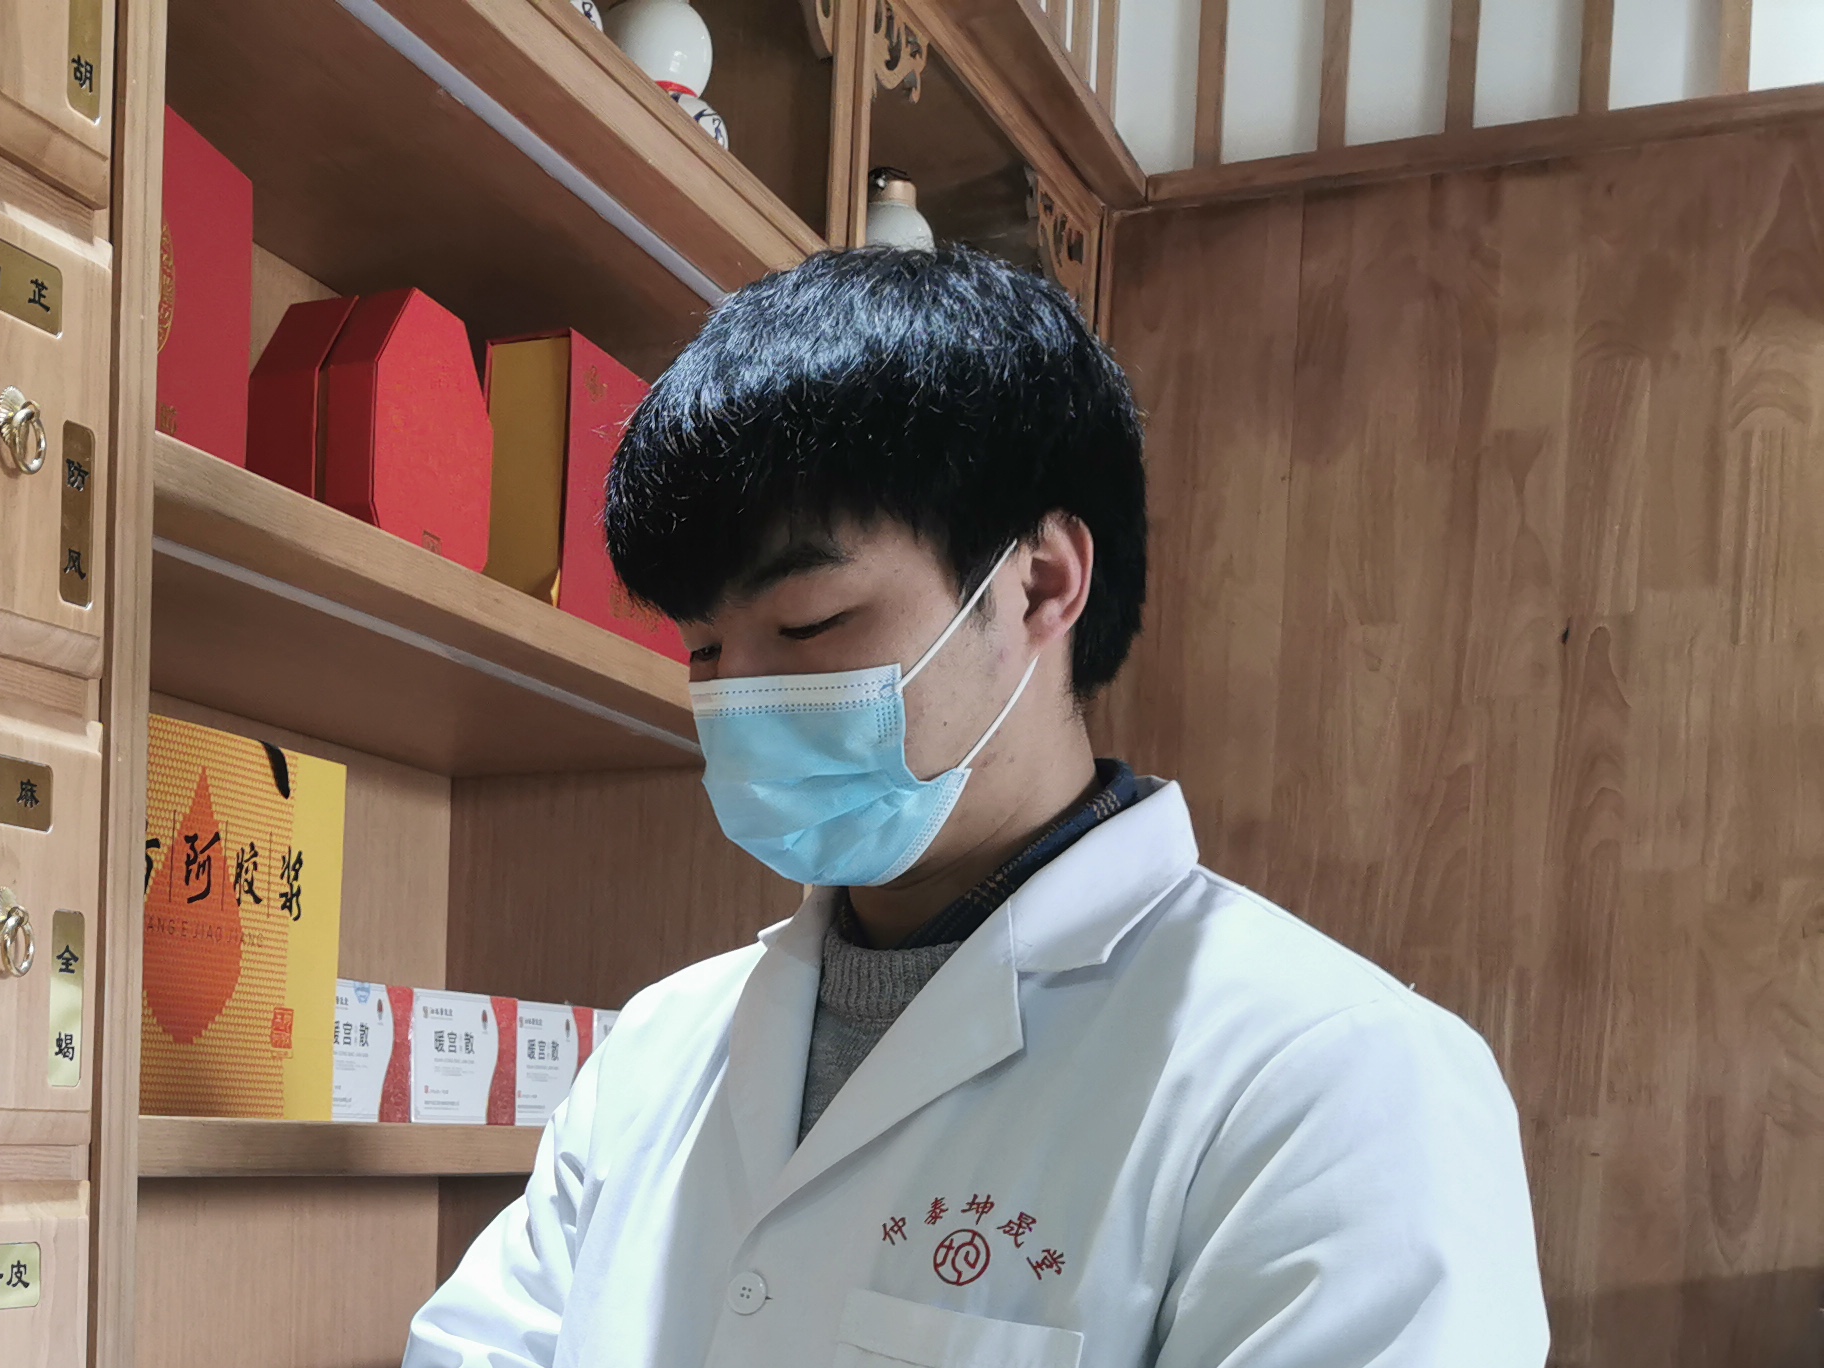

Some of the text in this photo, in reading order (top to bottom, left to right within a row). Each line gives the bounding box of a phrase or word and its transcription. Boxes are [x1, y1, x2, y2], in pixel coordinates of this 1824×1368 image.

[71, 55, 93, 92] 胡
[63, 458, 90, 580] 防风
[55, 944, 78, 1061] 全蝎
